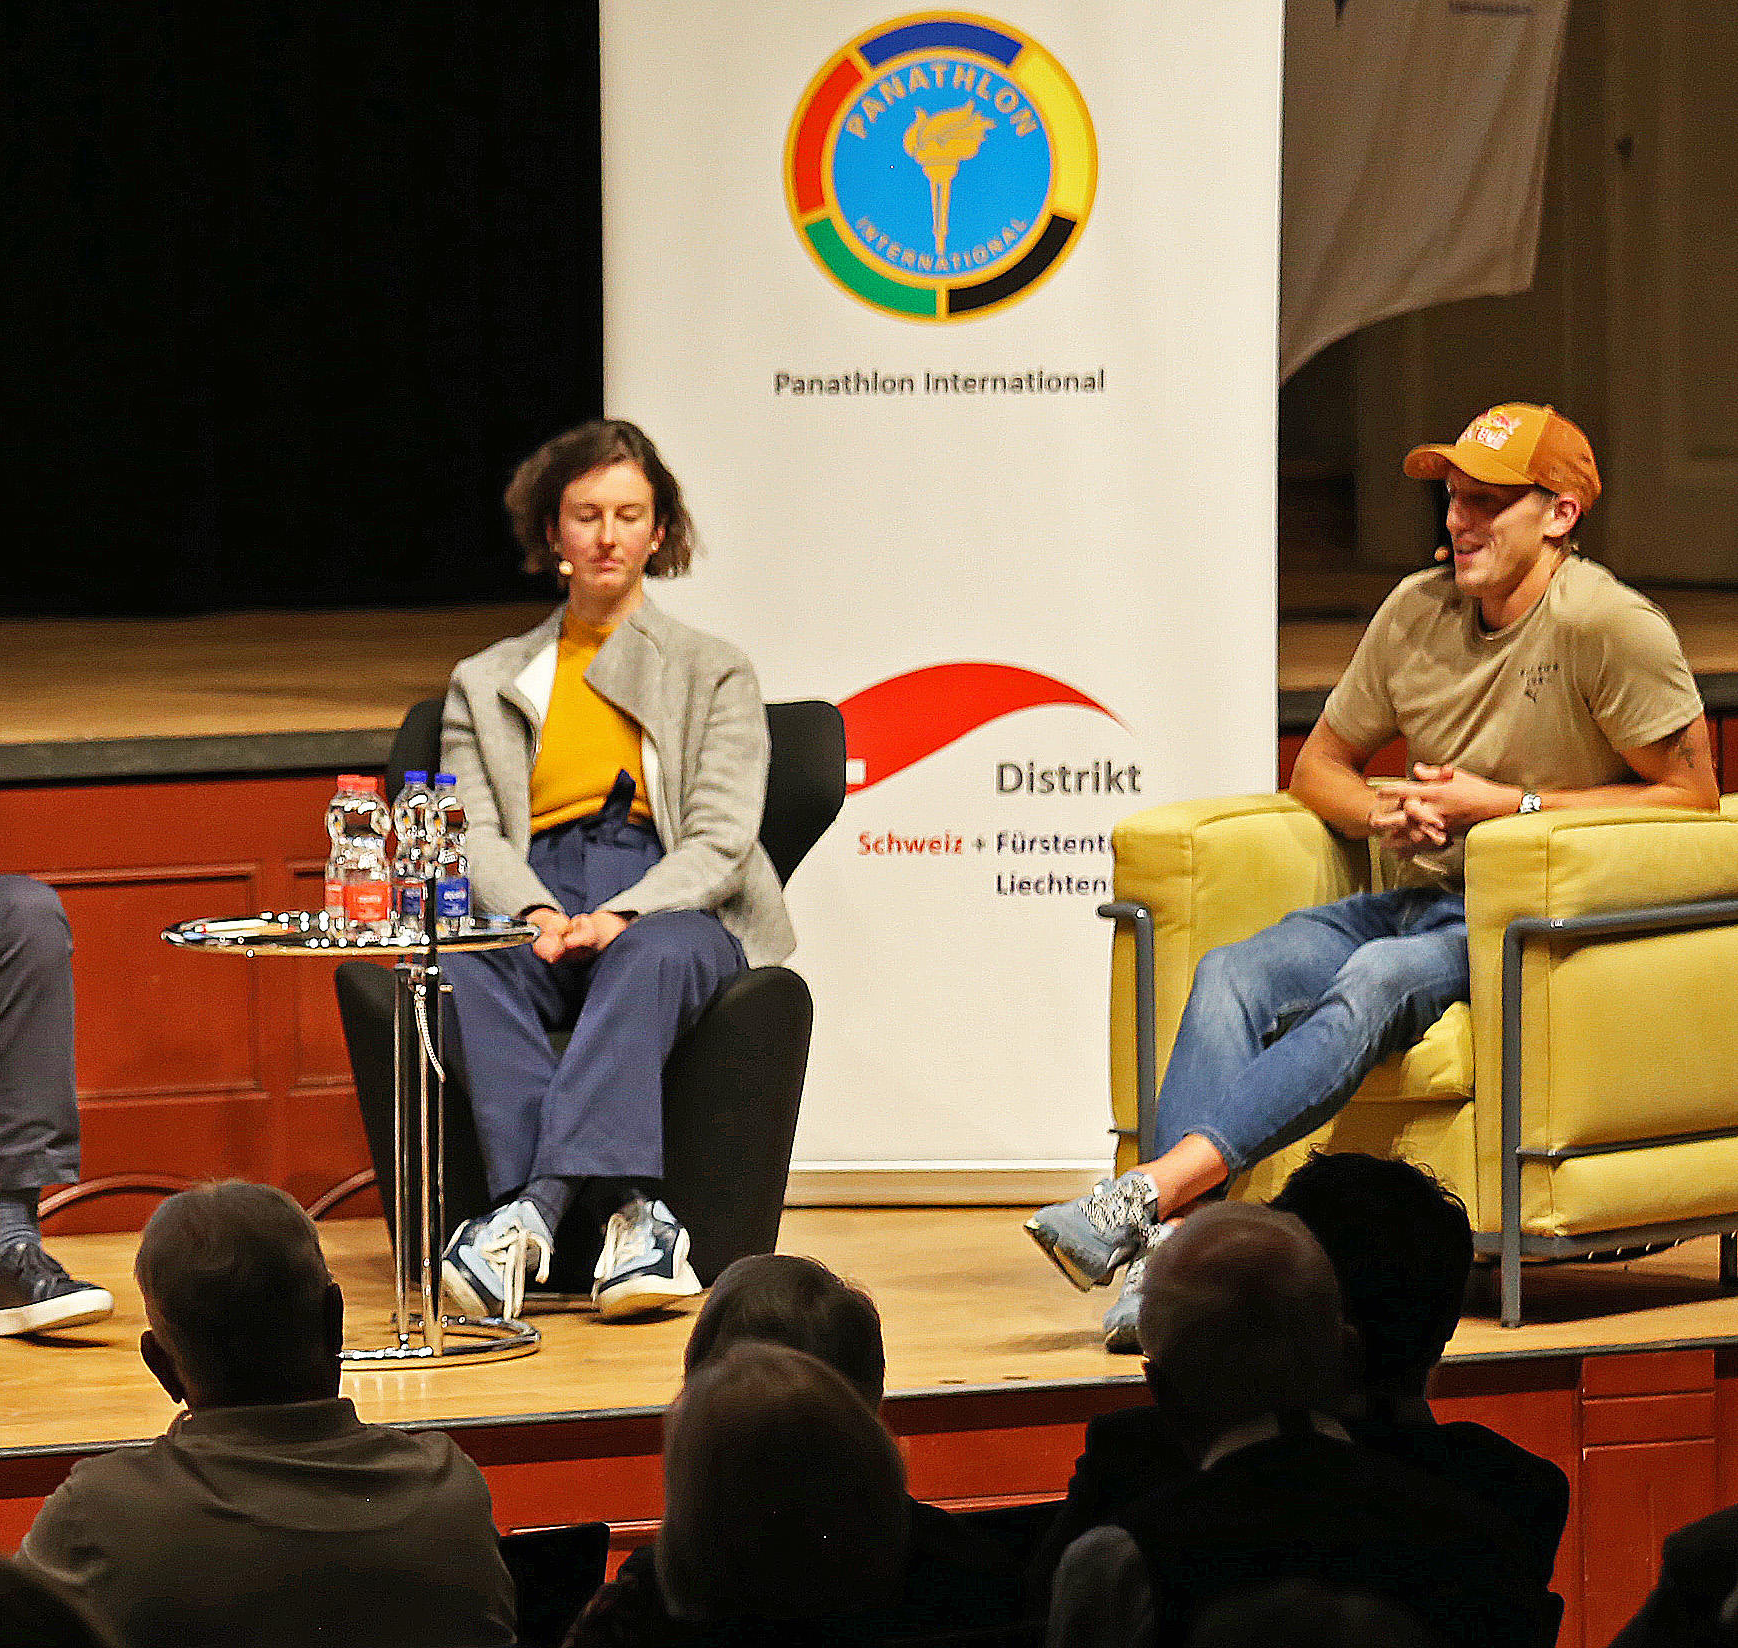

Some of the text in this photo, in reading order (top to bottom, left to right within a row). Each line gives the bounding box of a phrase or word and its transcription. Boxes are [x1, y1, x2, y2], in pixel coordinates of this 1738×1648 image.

[845, 62, 1038, 138] PANATHLON
[856, 217, 1028, 271] INTERNATIONAL
[774, 368, 1105, 394] Panathlon International
[996, 761, 1142, 794] Distrikt
[858, 830, 962, 855] Schweiz
